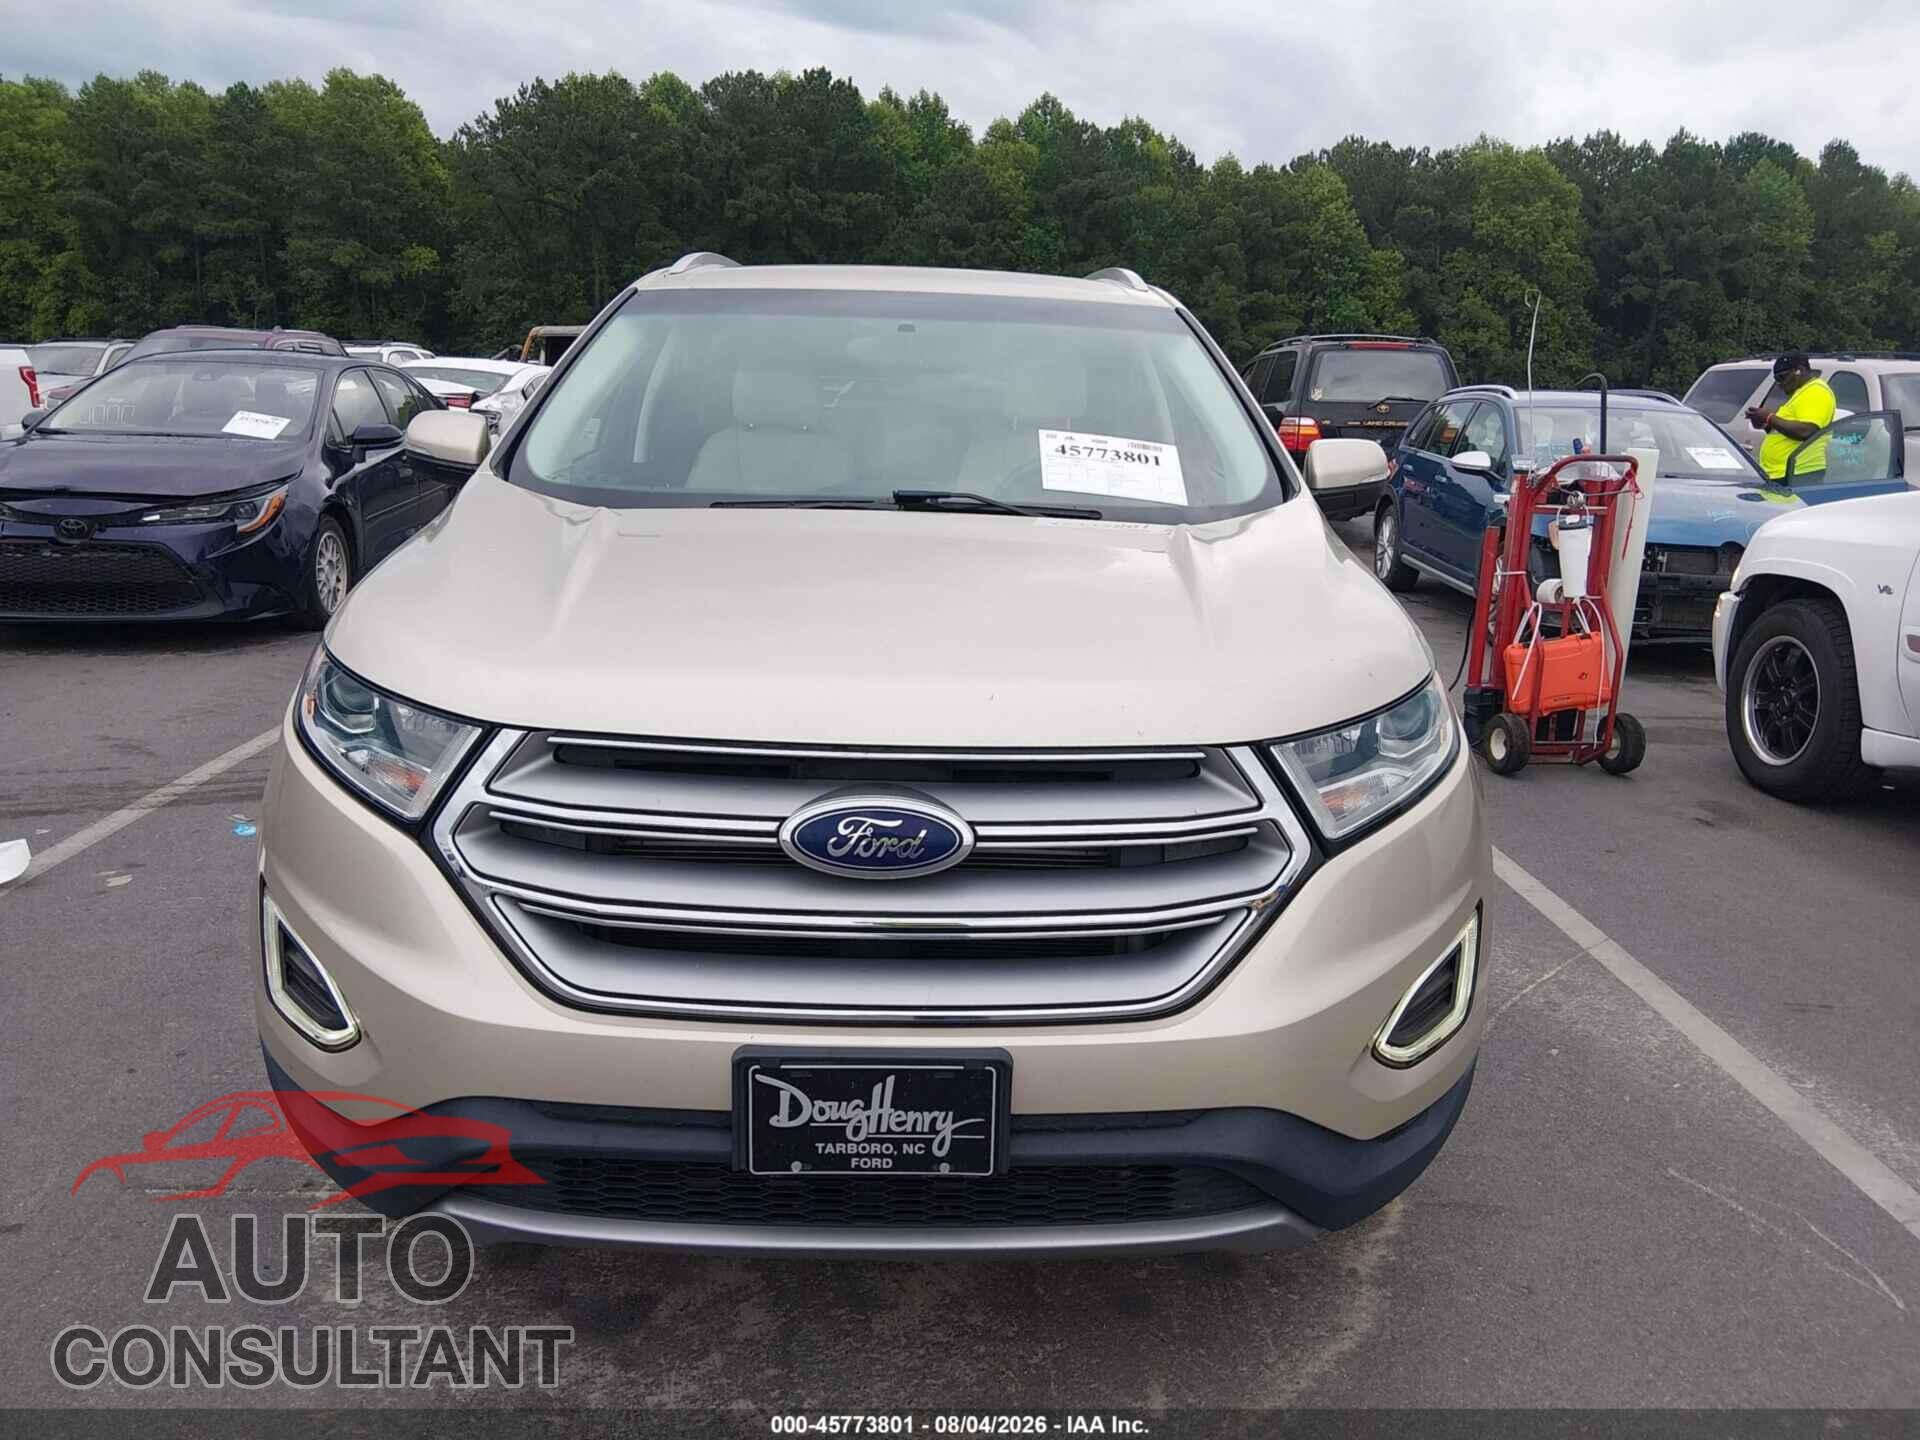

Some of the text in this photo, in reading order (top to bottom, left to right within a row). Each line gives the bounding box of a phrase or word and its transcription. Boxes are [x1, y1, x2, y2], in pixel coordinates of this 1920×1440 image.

[1055, 444, 1160, 467] 45773801
[827, 816, 927, 859] Ford
[815, 1142, 926, 1156] TARBORO, NC
[851, 1158, 893, 1169] FORD
